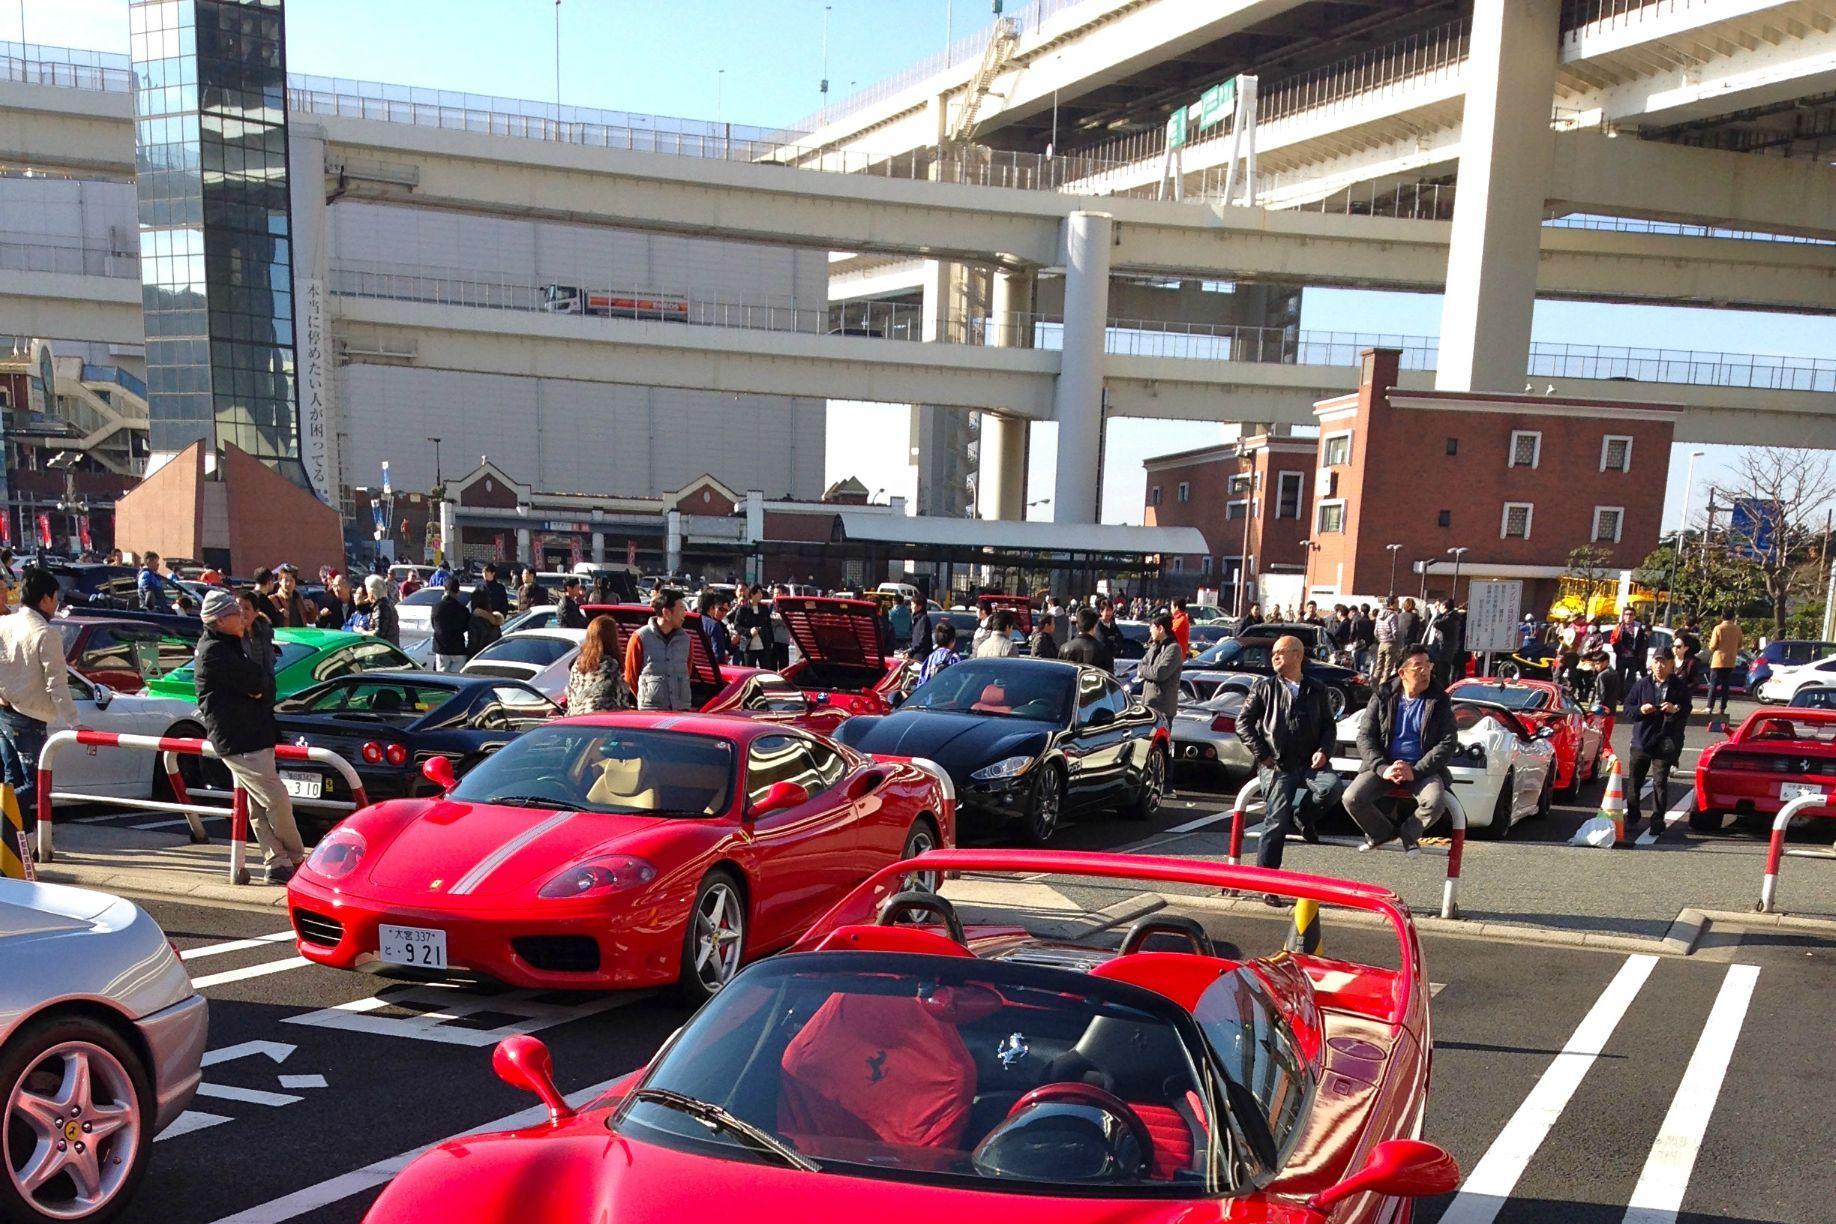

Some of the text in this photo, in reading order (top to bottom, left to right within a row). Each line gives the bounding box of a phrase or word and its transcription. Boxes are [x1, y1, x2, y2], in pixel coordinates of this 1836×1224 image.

[307, 285, 325, 482] 本当に停めたい人が困ってる
